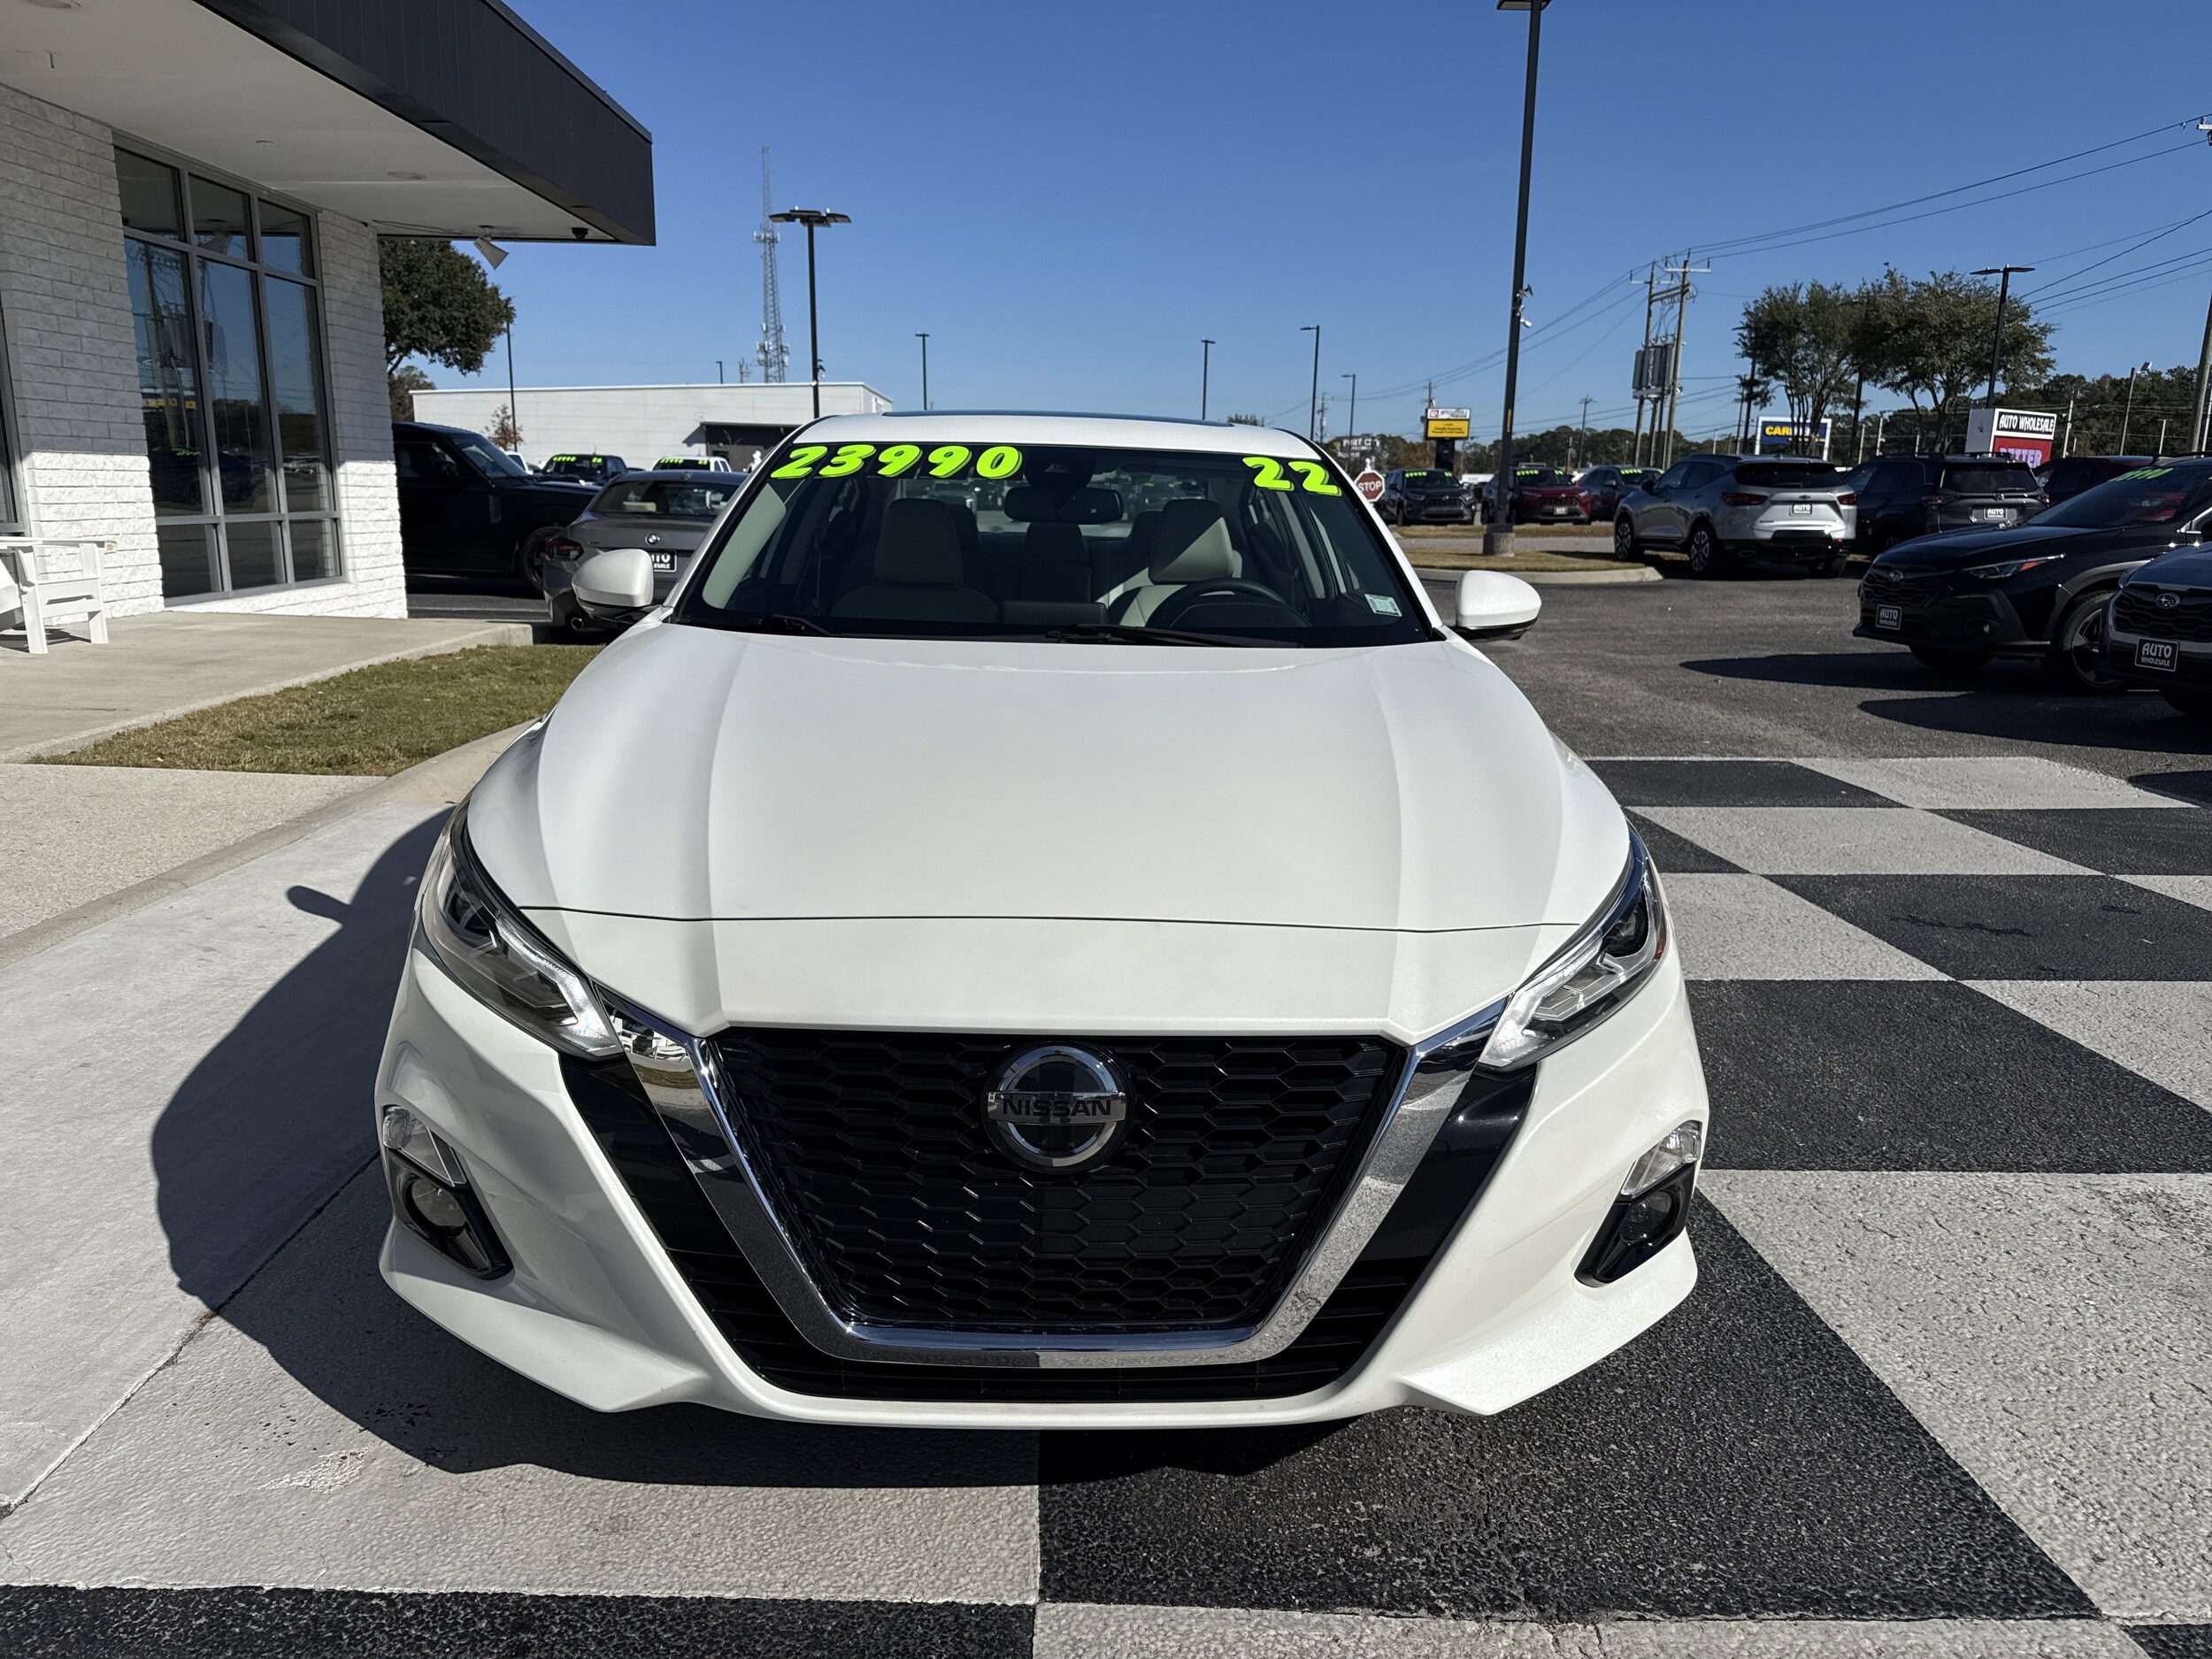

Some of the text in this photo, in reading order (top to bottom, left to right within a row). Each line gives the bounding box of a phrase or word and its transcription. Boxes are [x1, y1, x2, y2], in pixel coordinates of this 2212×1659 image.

[2000, 414, 2054, 433] AUTO WHOLESALE
[770, 444, 1342, 496] 23990 22
[1357, 481, 1381, 492] STOP
[1879, 608, 1899, 619] AUTO
[2142, 642, 2172, 658] AUTO
[2141, 656, 2170, 667] WHOLESALE
[1002, 1099, 1111, 1117] NISSAN
